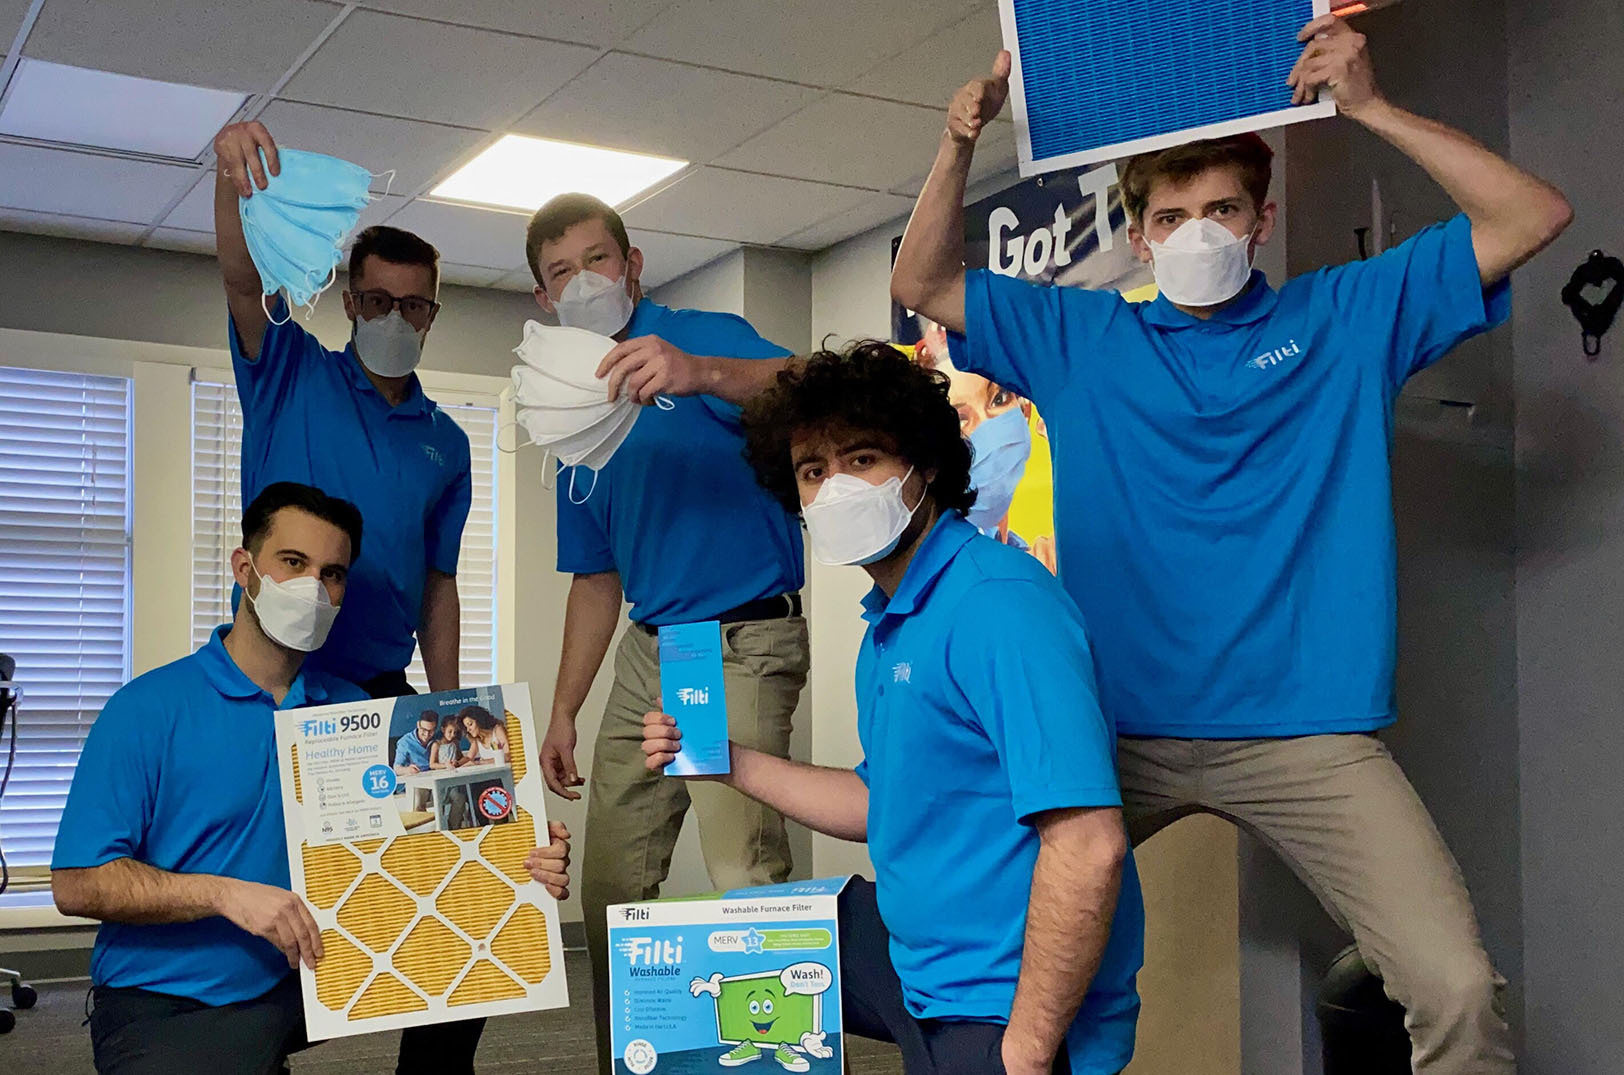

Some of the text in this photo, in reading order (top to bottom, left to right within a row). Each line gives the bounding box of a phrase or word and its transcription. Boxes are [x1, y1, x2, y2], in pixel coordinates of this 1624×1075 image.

[988, 203, 1072, 278] Got
[1247, 339, 1300, 370] Filti
[439, 698, 462, 707] Breathe
[676, 687, 709, 706] Filti
[299, 718, 337, 737] Filti
[340, 712, 381, 733] 9500
[305, 747, 346, 761] Healthy
[348, 744, 379, 755] Home
[370, 776, 390, 790] 16
[619, 907, 651, 921] Filti
[722, 905, 759, 914] Washable
[760, 904, 791, 913] Furnace
[713, 935, 739, 945] MERV
[747, 936, 759, 947] 13
[617, 936, 684, 966] Filti
[629, 965, 681, 977] Washable
[790, 968, 824, 980] Wash!
